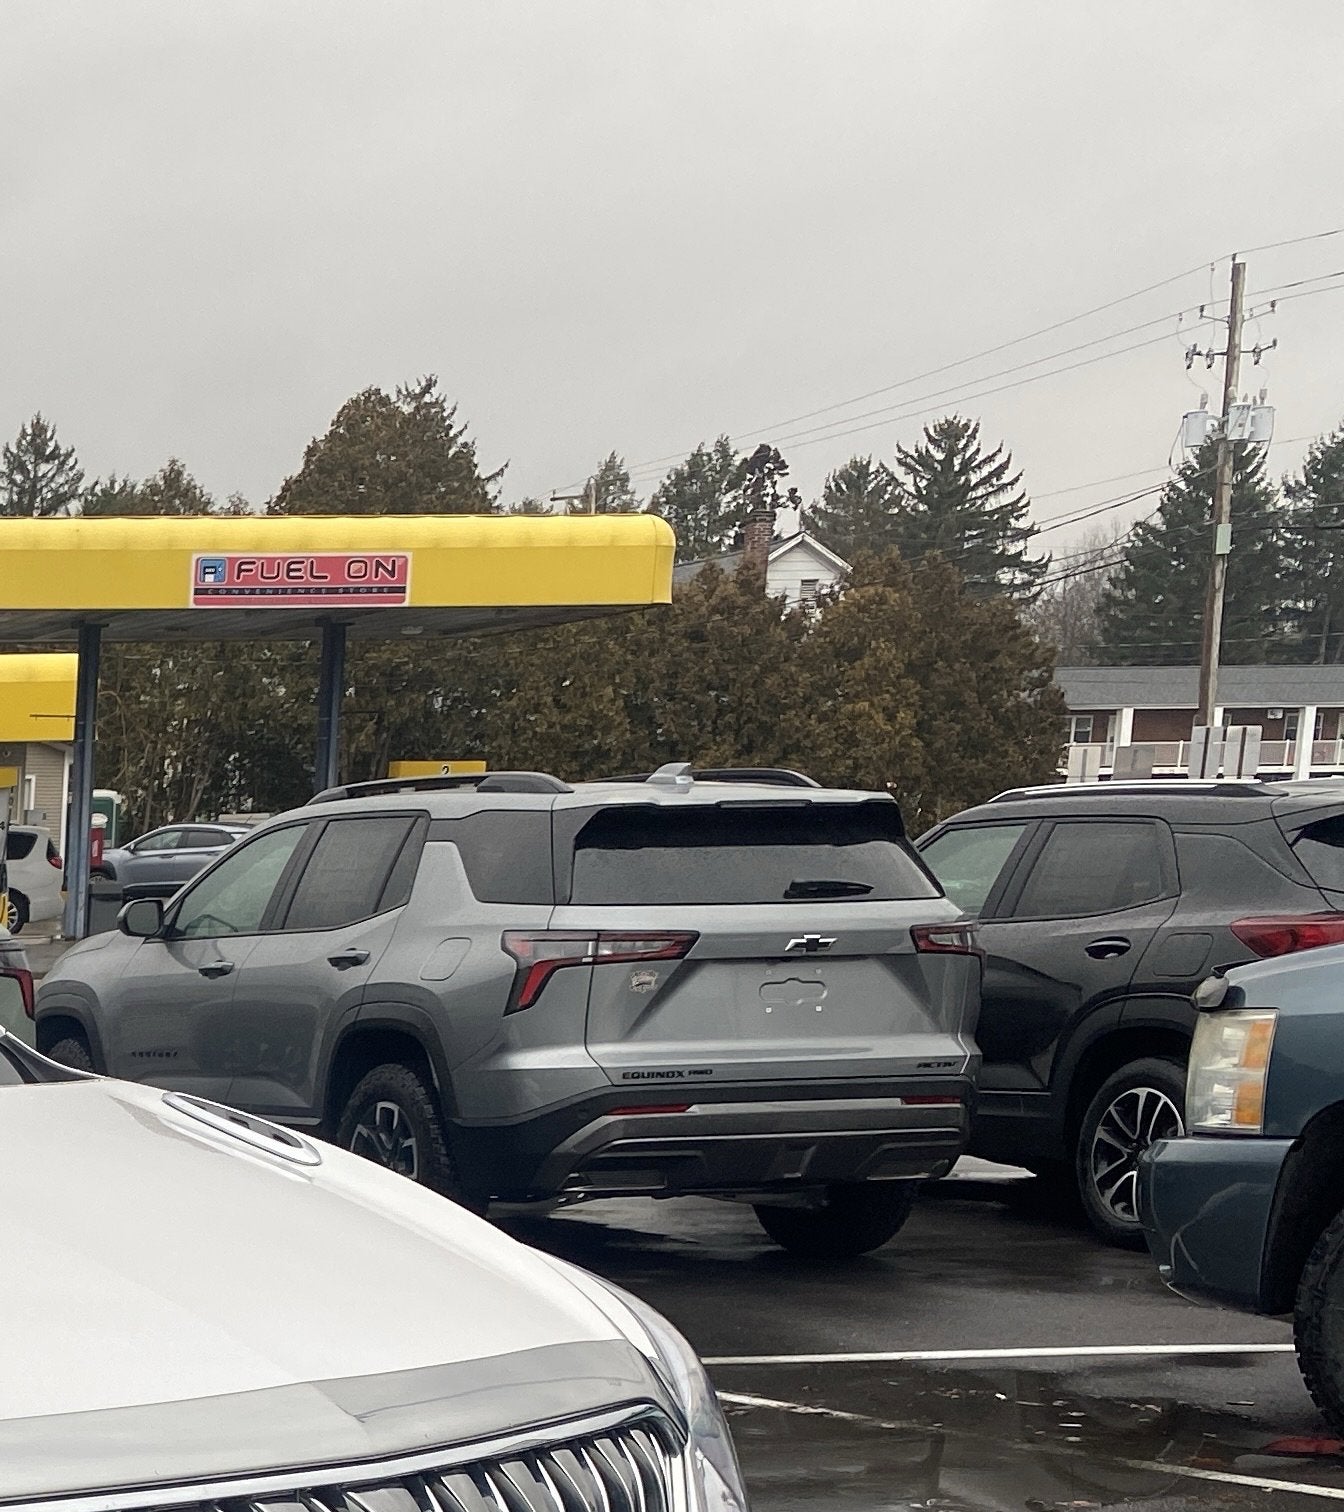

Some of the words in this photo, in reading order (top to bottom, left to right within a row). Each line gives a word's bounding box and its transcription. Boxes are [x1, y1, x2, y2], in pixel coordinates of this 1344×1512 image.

[235, 559, 329, 581] FUEL
[347, 559, 396, 580] ON
[622, 1070, 685, 1080] EQUINOX
